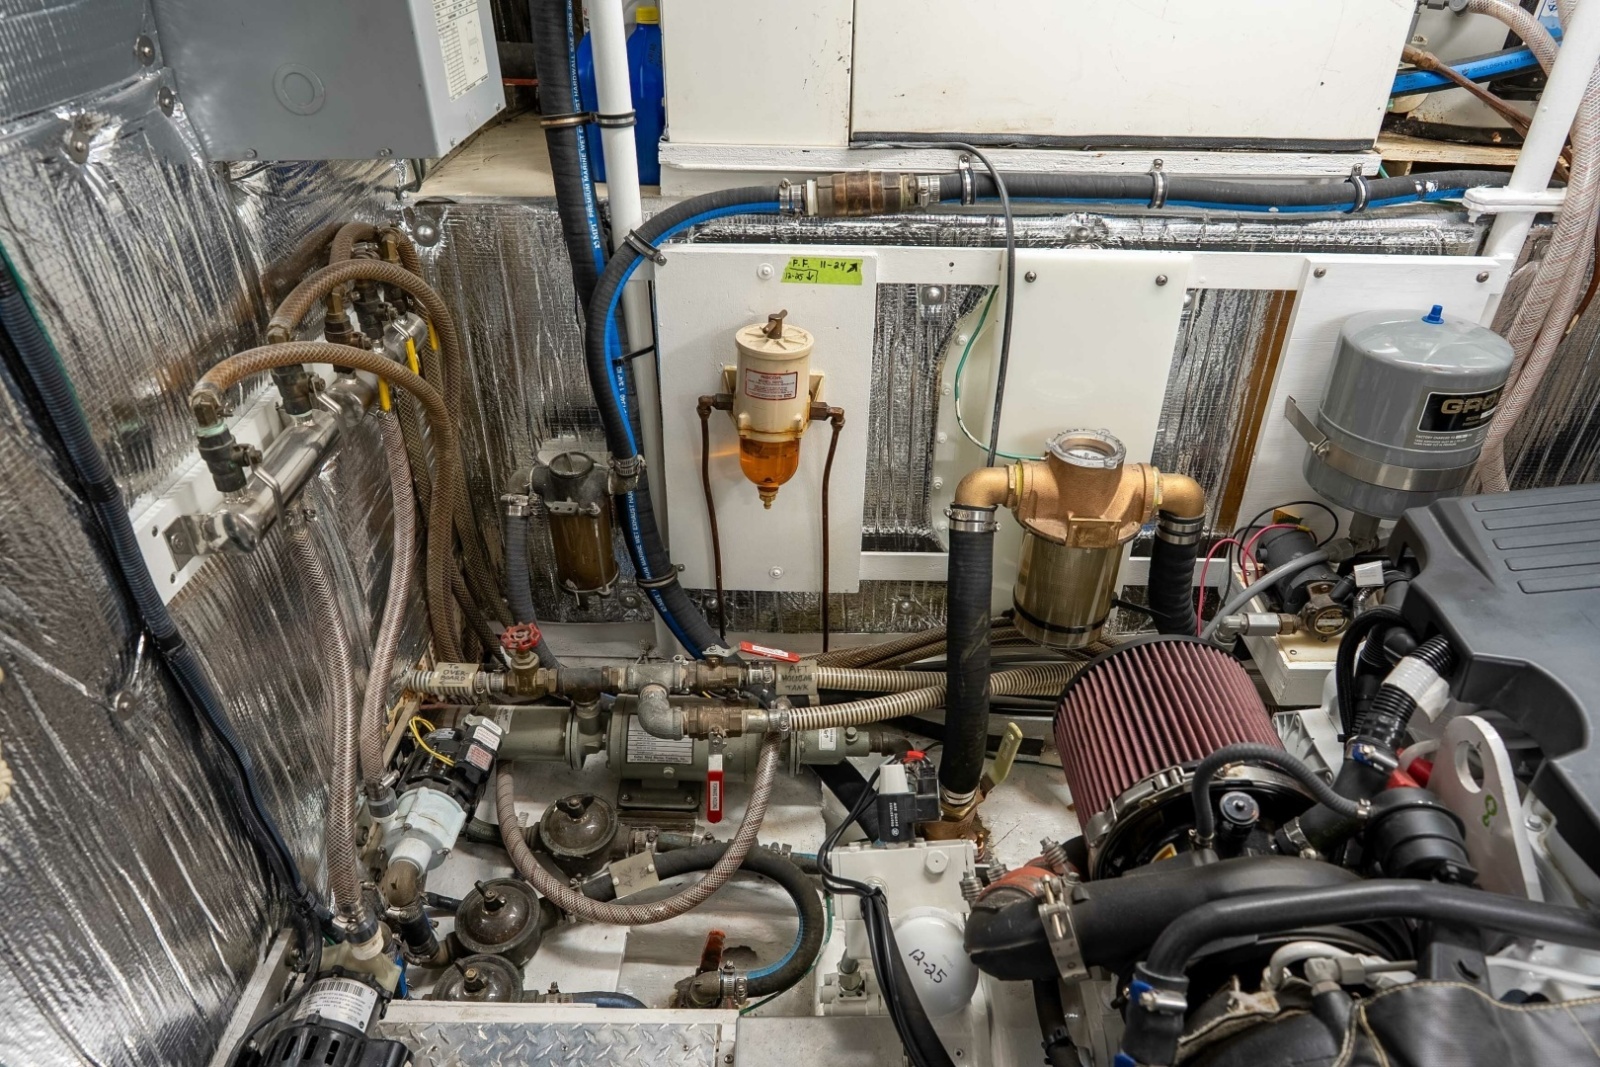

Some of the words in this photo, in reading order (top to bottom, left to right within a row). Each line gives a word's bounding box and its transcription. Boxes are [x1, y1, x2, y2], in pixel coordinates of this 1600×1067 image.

[568, 38, 576, 53] SAE
[570, 55, 580, 97] HARDWALL
[579, 136, 587, 152] WET
[580, 153, 590, 182] MARINE
[584, 183, 594, 218] PREMIUM
[820, 260, 846, 271] 11-24
[629, 505, 639, 530] EXHAUST
[789, 665, 810, 673] AFT
[908, 948, 948, 984] 12-25
